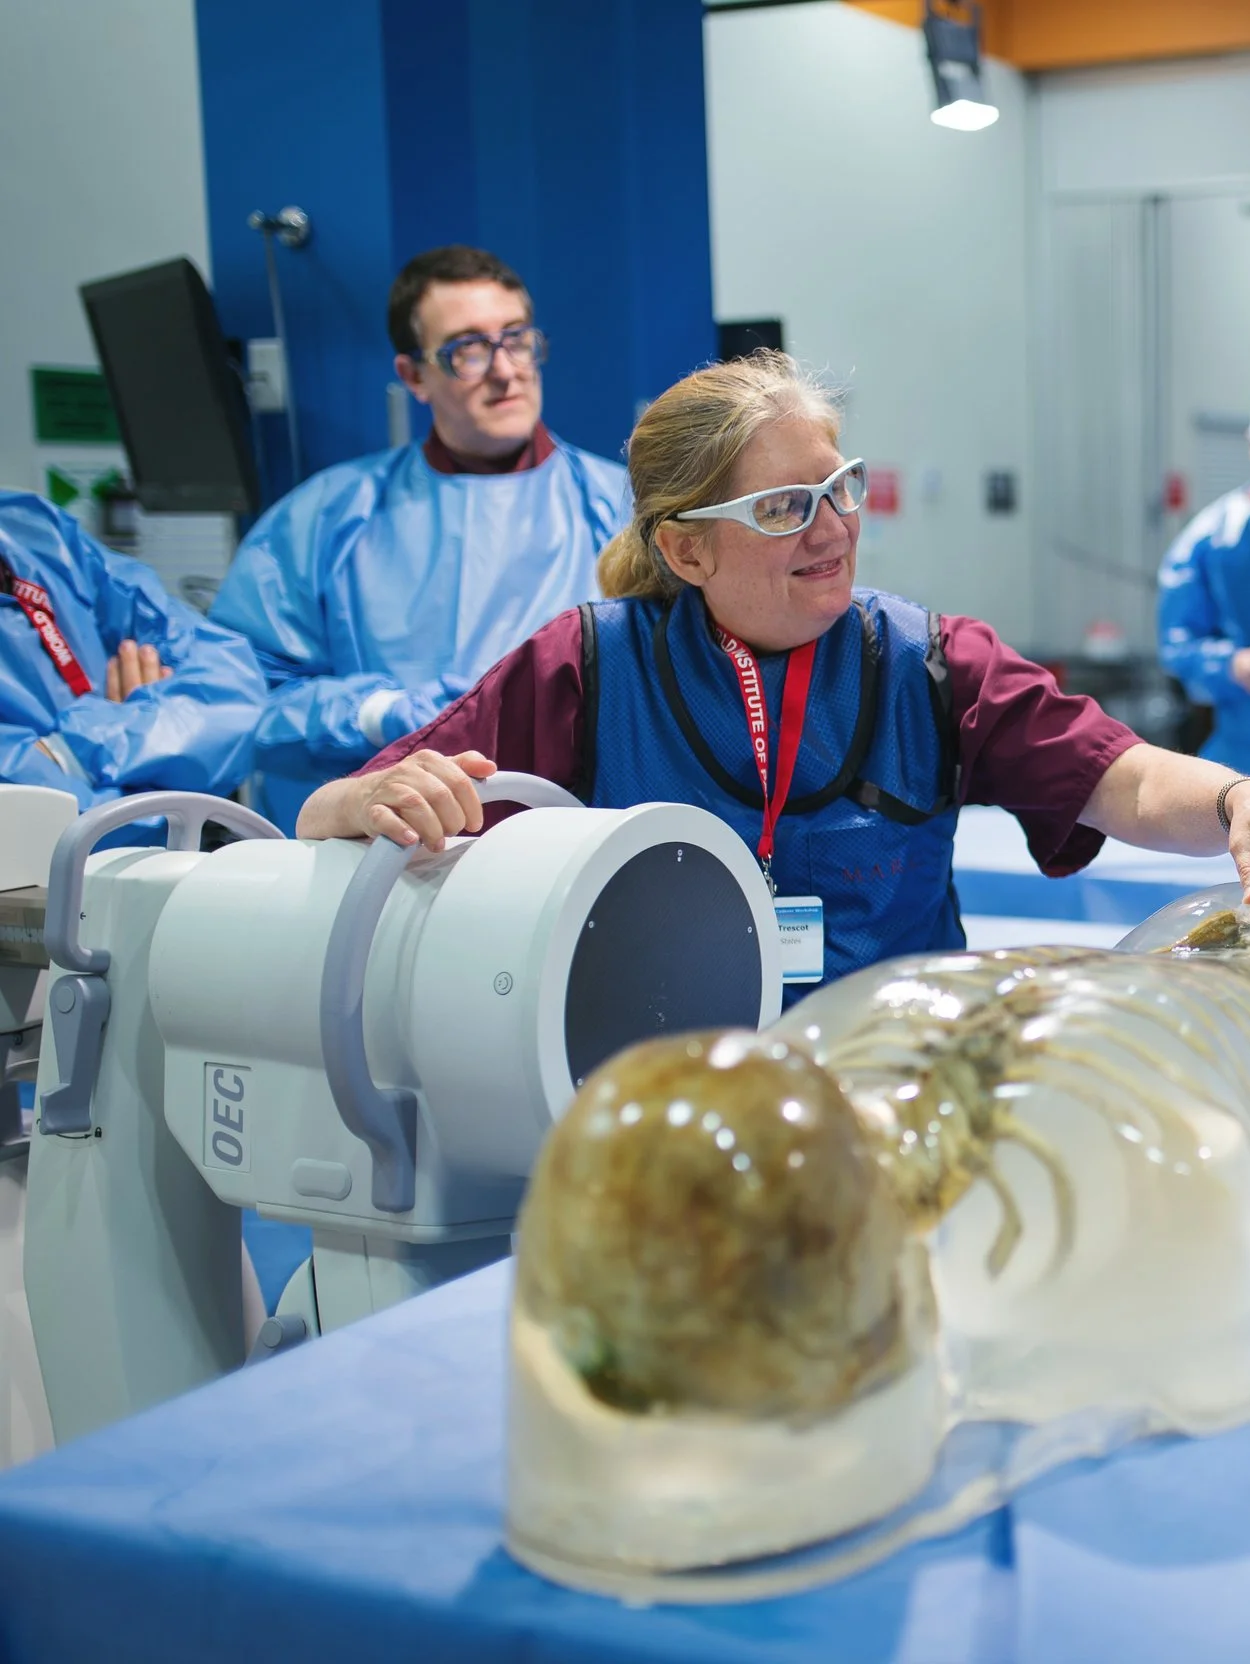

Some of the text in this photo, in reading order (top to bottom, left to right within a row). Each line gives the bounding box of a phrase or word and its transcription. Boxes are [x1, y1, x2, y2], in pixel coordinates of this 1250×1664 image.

[33, 609, 73, 667] WORLD
[755, 737, 767, 764] OF
[212, 1068, 245, 1167] OEC
